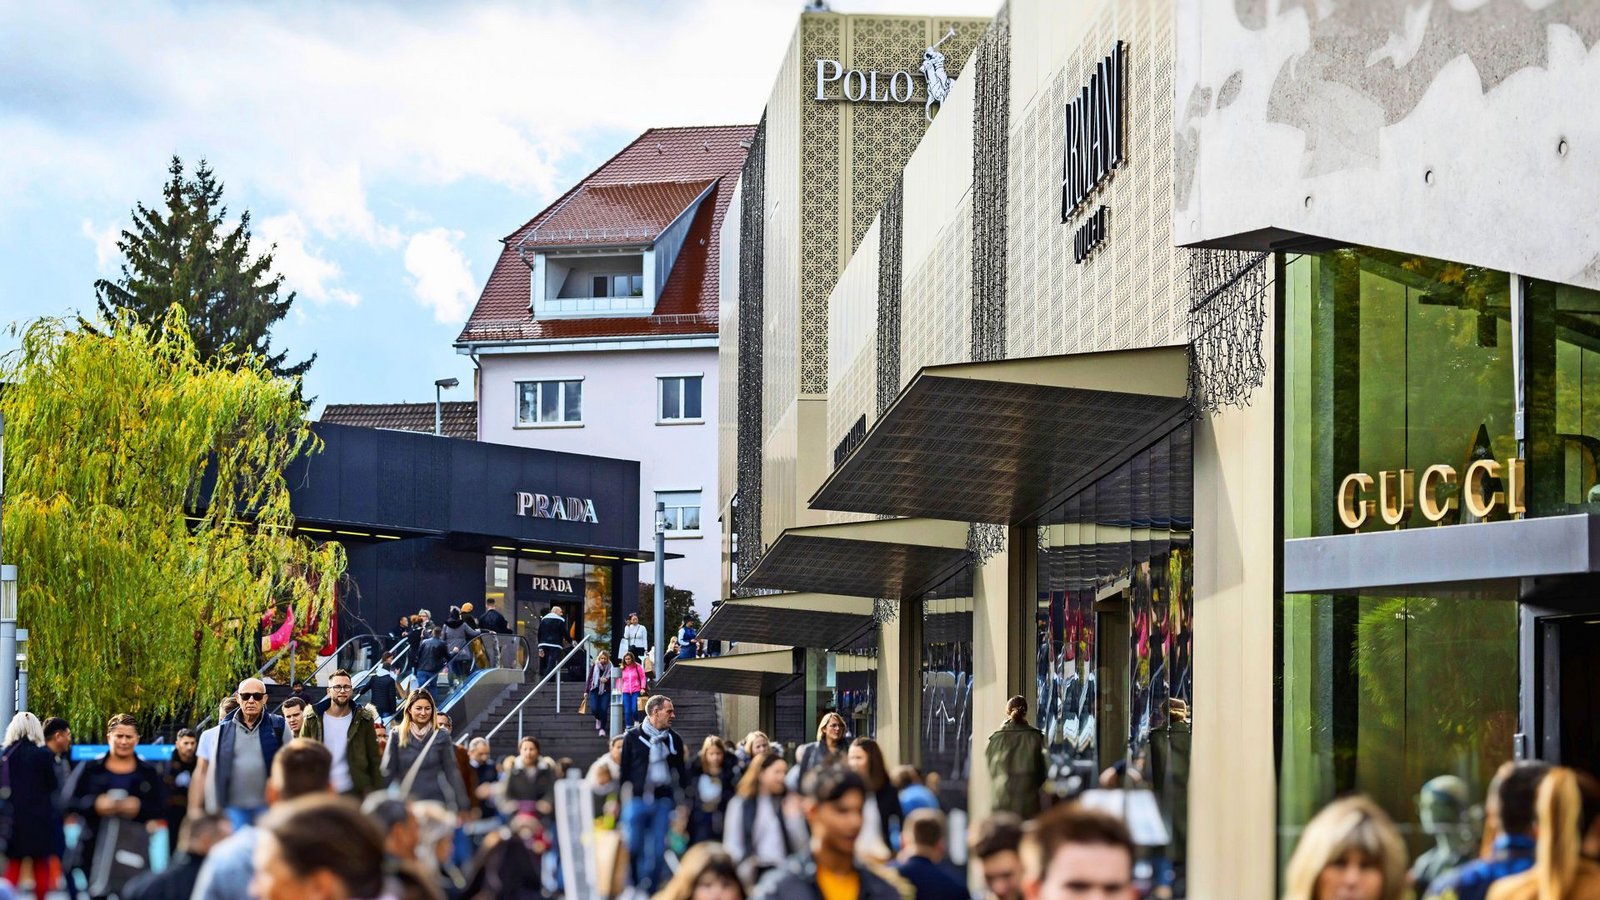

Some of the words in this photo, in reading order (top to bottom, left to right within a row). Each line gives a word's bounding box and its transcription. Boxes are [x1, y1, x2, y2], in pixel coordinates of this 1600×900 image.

[515, 491, 599, 524] PRADA
[1337, 457, 1526, 530] GUCCI
[532, 577, 573, 593] PRADA
